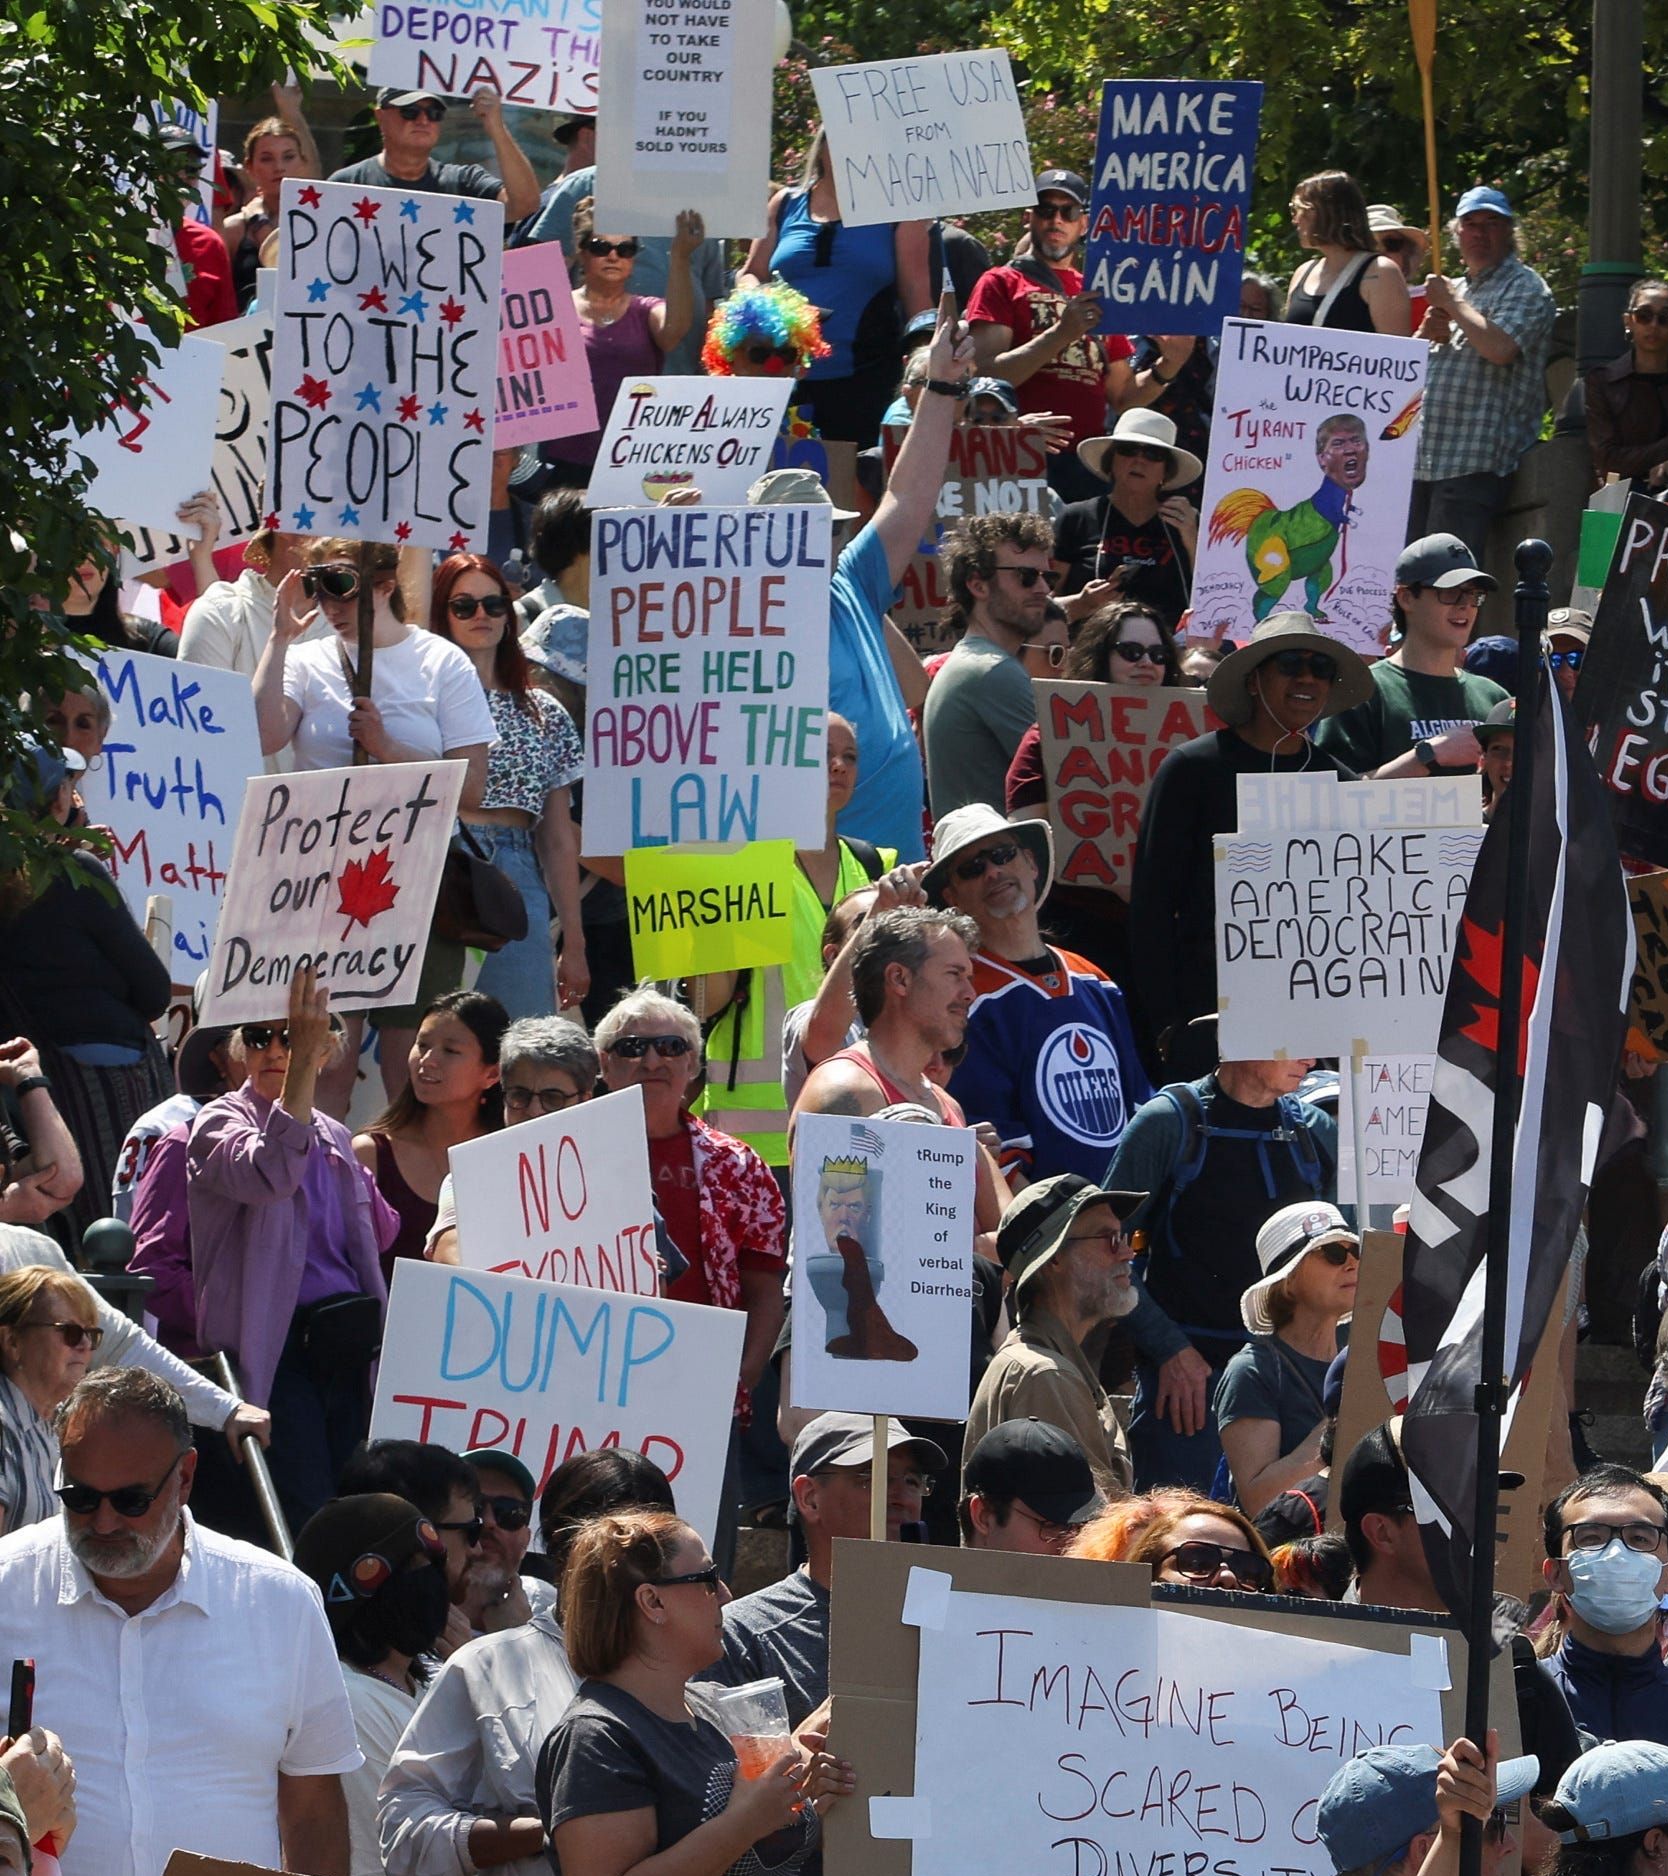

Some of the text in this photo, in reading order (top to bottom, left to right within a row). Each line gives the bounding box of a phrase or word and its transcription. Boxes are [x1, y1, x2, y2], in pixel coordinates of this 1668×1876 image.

[381, 4, 520, 53] DEPORT
[645, 13, 730, 28] NOT HAVE
[649, 33, 720, 47] TO TAKE
[643, 69, 724, 83] COUNTRY
[666, 52, 702, 65] OUR
[659, 110, 707, 123] IF YOU
[837, 64, 928, 123] FREE
[1113, 93, 1235, 137] MAKE
[635, 140, 727, 154] SOLD YOURS
[655, 125, 709, 138] HADN'T
[904, 121, 952, 143] FROM
[845, 140, 1035, 210] MAGA NAZIS
[288, 210, 487, 302] POWER
[285, 312, 478, 398] TO THE
[1228, 322, 1422, 382] TRUMPASAURUS
[630, 392, 774, 432] TRUMP ALWAYS
[1285, 374, 1395, 413] WRECKS
[274, 400, 482, 529] PEOPLE
[610, 434, 762, 468] CHICKENS OUT
[600, 512, 827, 575] POWERFUL
[611, 574, 786, 648] PEOPLE
[613, 650, 796, 696] ARE HELD
[97, 657, 225, 738] Make
[592, 702, 822, 769] ABOVE THE
[98, 742, 226, 825] Truth
[256, 773, 438, 857] Protect
[631, 774, 760, 843] LAW
[1286, 834, 1429, 878] MAKE
[270, 867, 330, 914] our
[633, 880, 787, 934] MARSHAL
[1230, 872, 1470, 916] AMERICA
[217, 936, 416, 998] Democracy
[1288, 955, 1446, 1001] AGAIN
[1364, 1063, 1431, 1094] TAKE
[1056, 1070, 1121, 1135] OILERS
[915, 1147, 965, 1168] tRump
[518, 1136, 588, 1238] NO
[928, 1177, 952, 1190] the
[925, 1203, 958, 1221] King
[934, 1229, 949, 1242] of
[918, 1256, 964, 1271] verbal
[910, 1280, 972, 1299] Diarrhea
[440, 1278, 676, 1407] DUMP
[968, 1630, 1236, 1746] IMAGINE
[1038, 1753, 1267, 1844] SCARED
